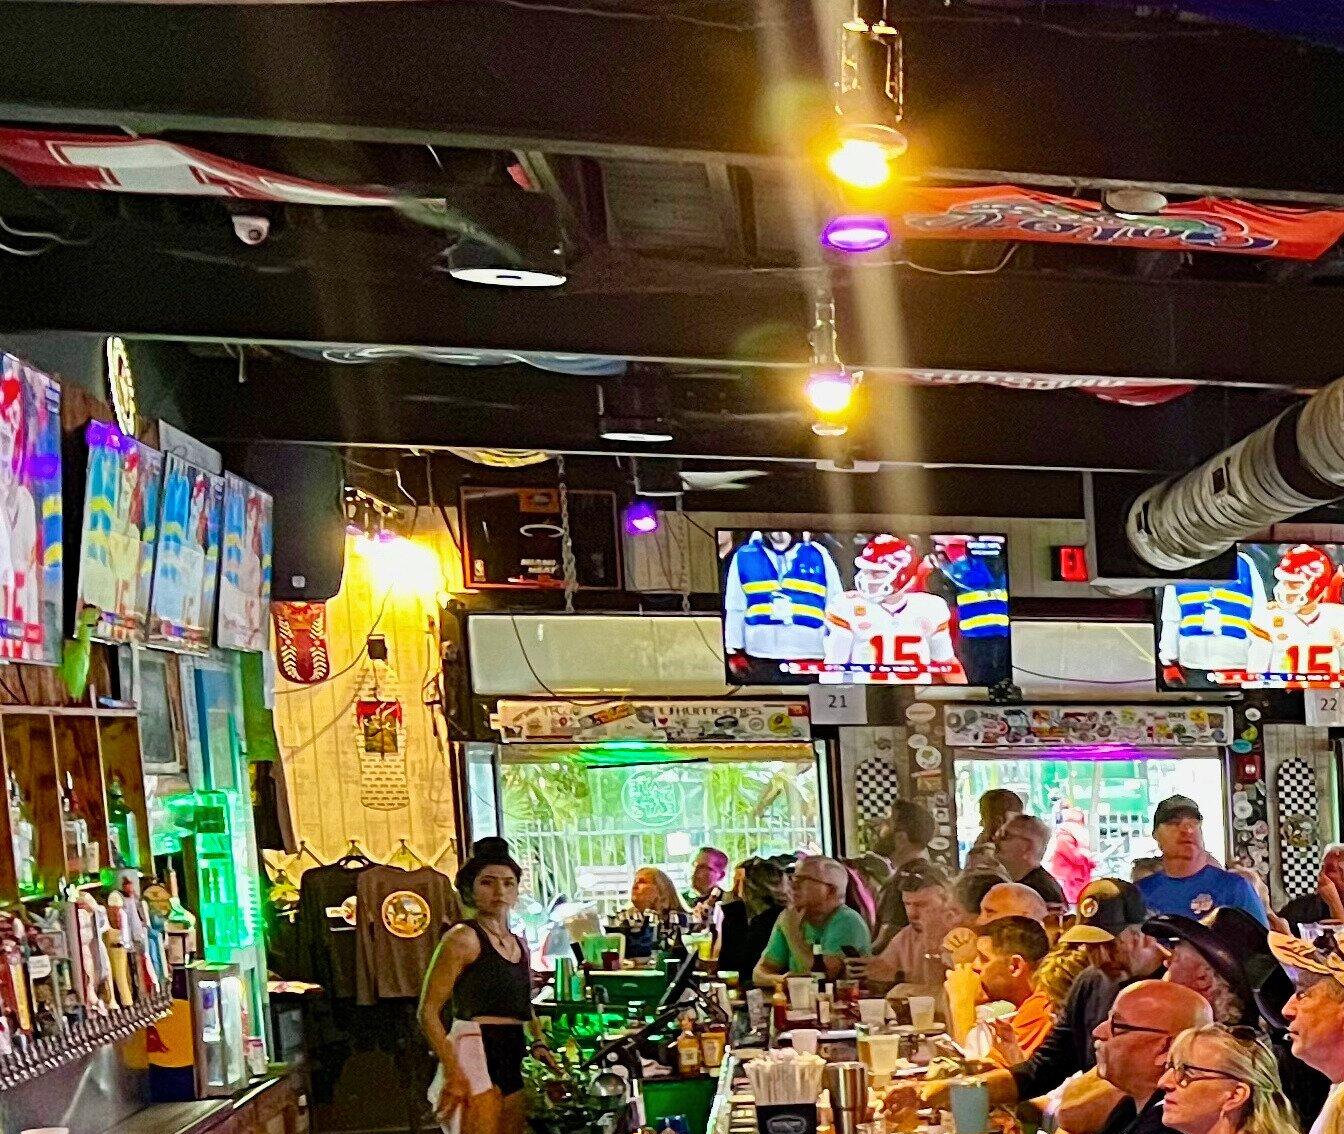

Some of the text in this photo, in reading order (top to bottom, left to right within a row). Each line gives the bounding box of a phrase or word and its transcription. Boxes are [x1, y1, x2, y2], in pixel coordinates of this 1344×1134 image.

[869, 635, 927, 671] 15
[1286, 645, 1334, 677] 15
[828, 694, 848, 709] 21
[1320, 698, 1339, 711] 22
